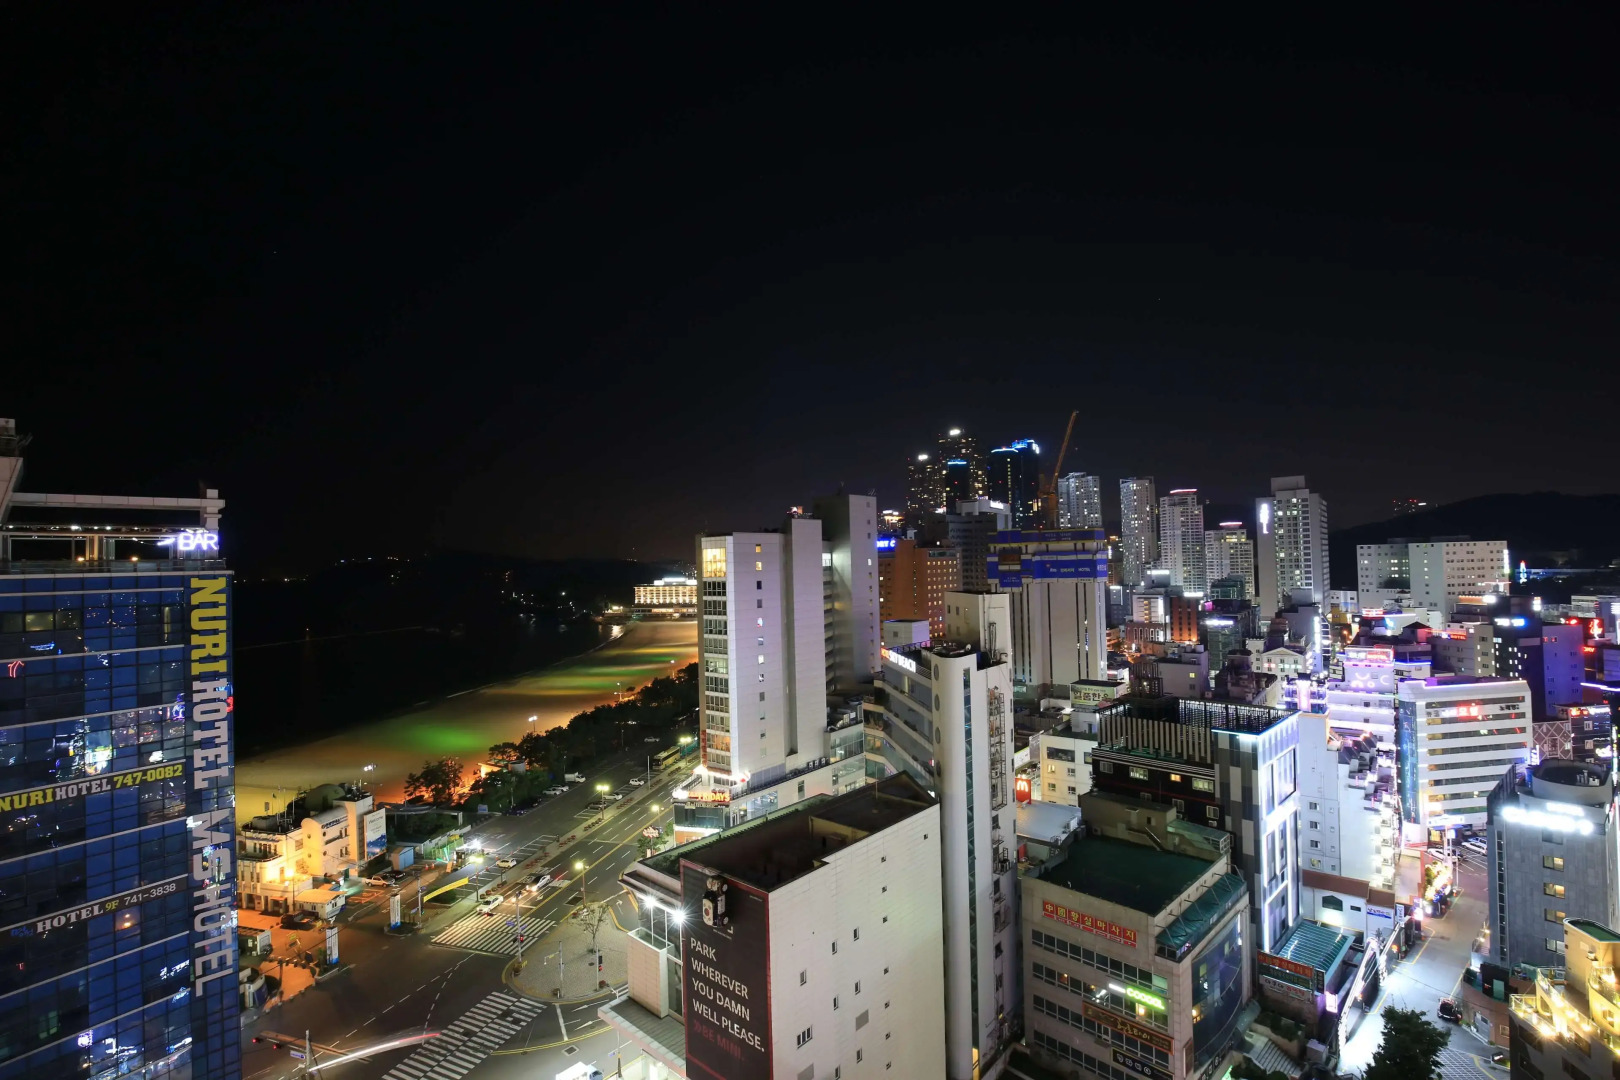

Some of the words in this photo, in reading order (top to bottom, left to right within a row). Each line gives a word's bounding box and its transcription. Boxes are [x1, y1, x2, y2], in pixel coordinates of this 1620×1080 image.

[178, 532, 218, 550] BAR
[190, 577, 227, 675] NURI
[192, 678, 229, 789] HOTEL
[55, 779, 111, 801] HOTEL
[114, 764, 183, 789] 747-0082
[36, 904, 103, 934] HOTEL
[105, 900, 120, 912] 9F
[124, 882, 177, 907] 741-3838
[690, 937, 717, 962] PARK
[691, 957, 749, 1000] WHEREVER
[692, 977, 714, 1000] YOU
[716, 991, 750, 1022] DAMN
[693, 998, 720, 1025] WELL
[721, 1016, 765, 1052] PLEASE.
